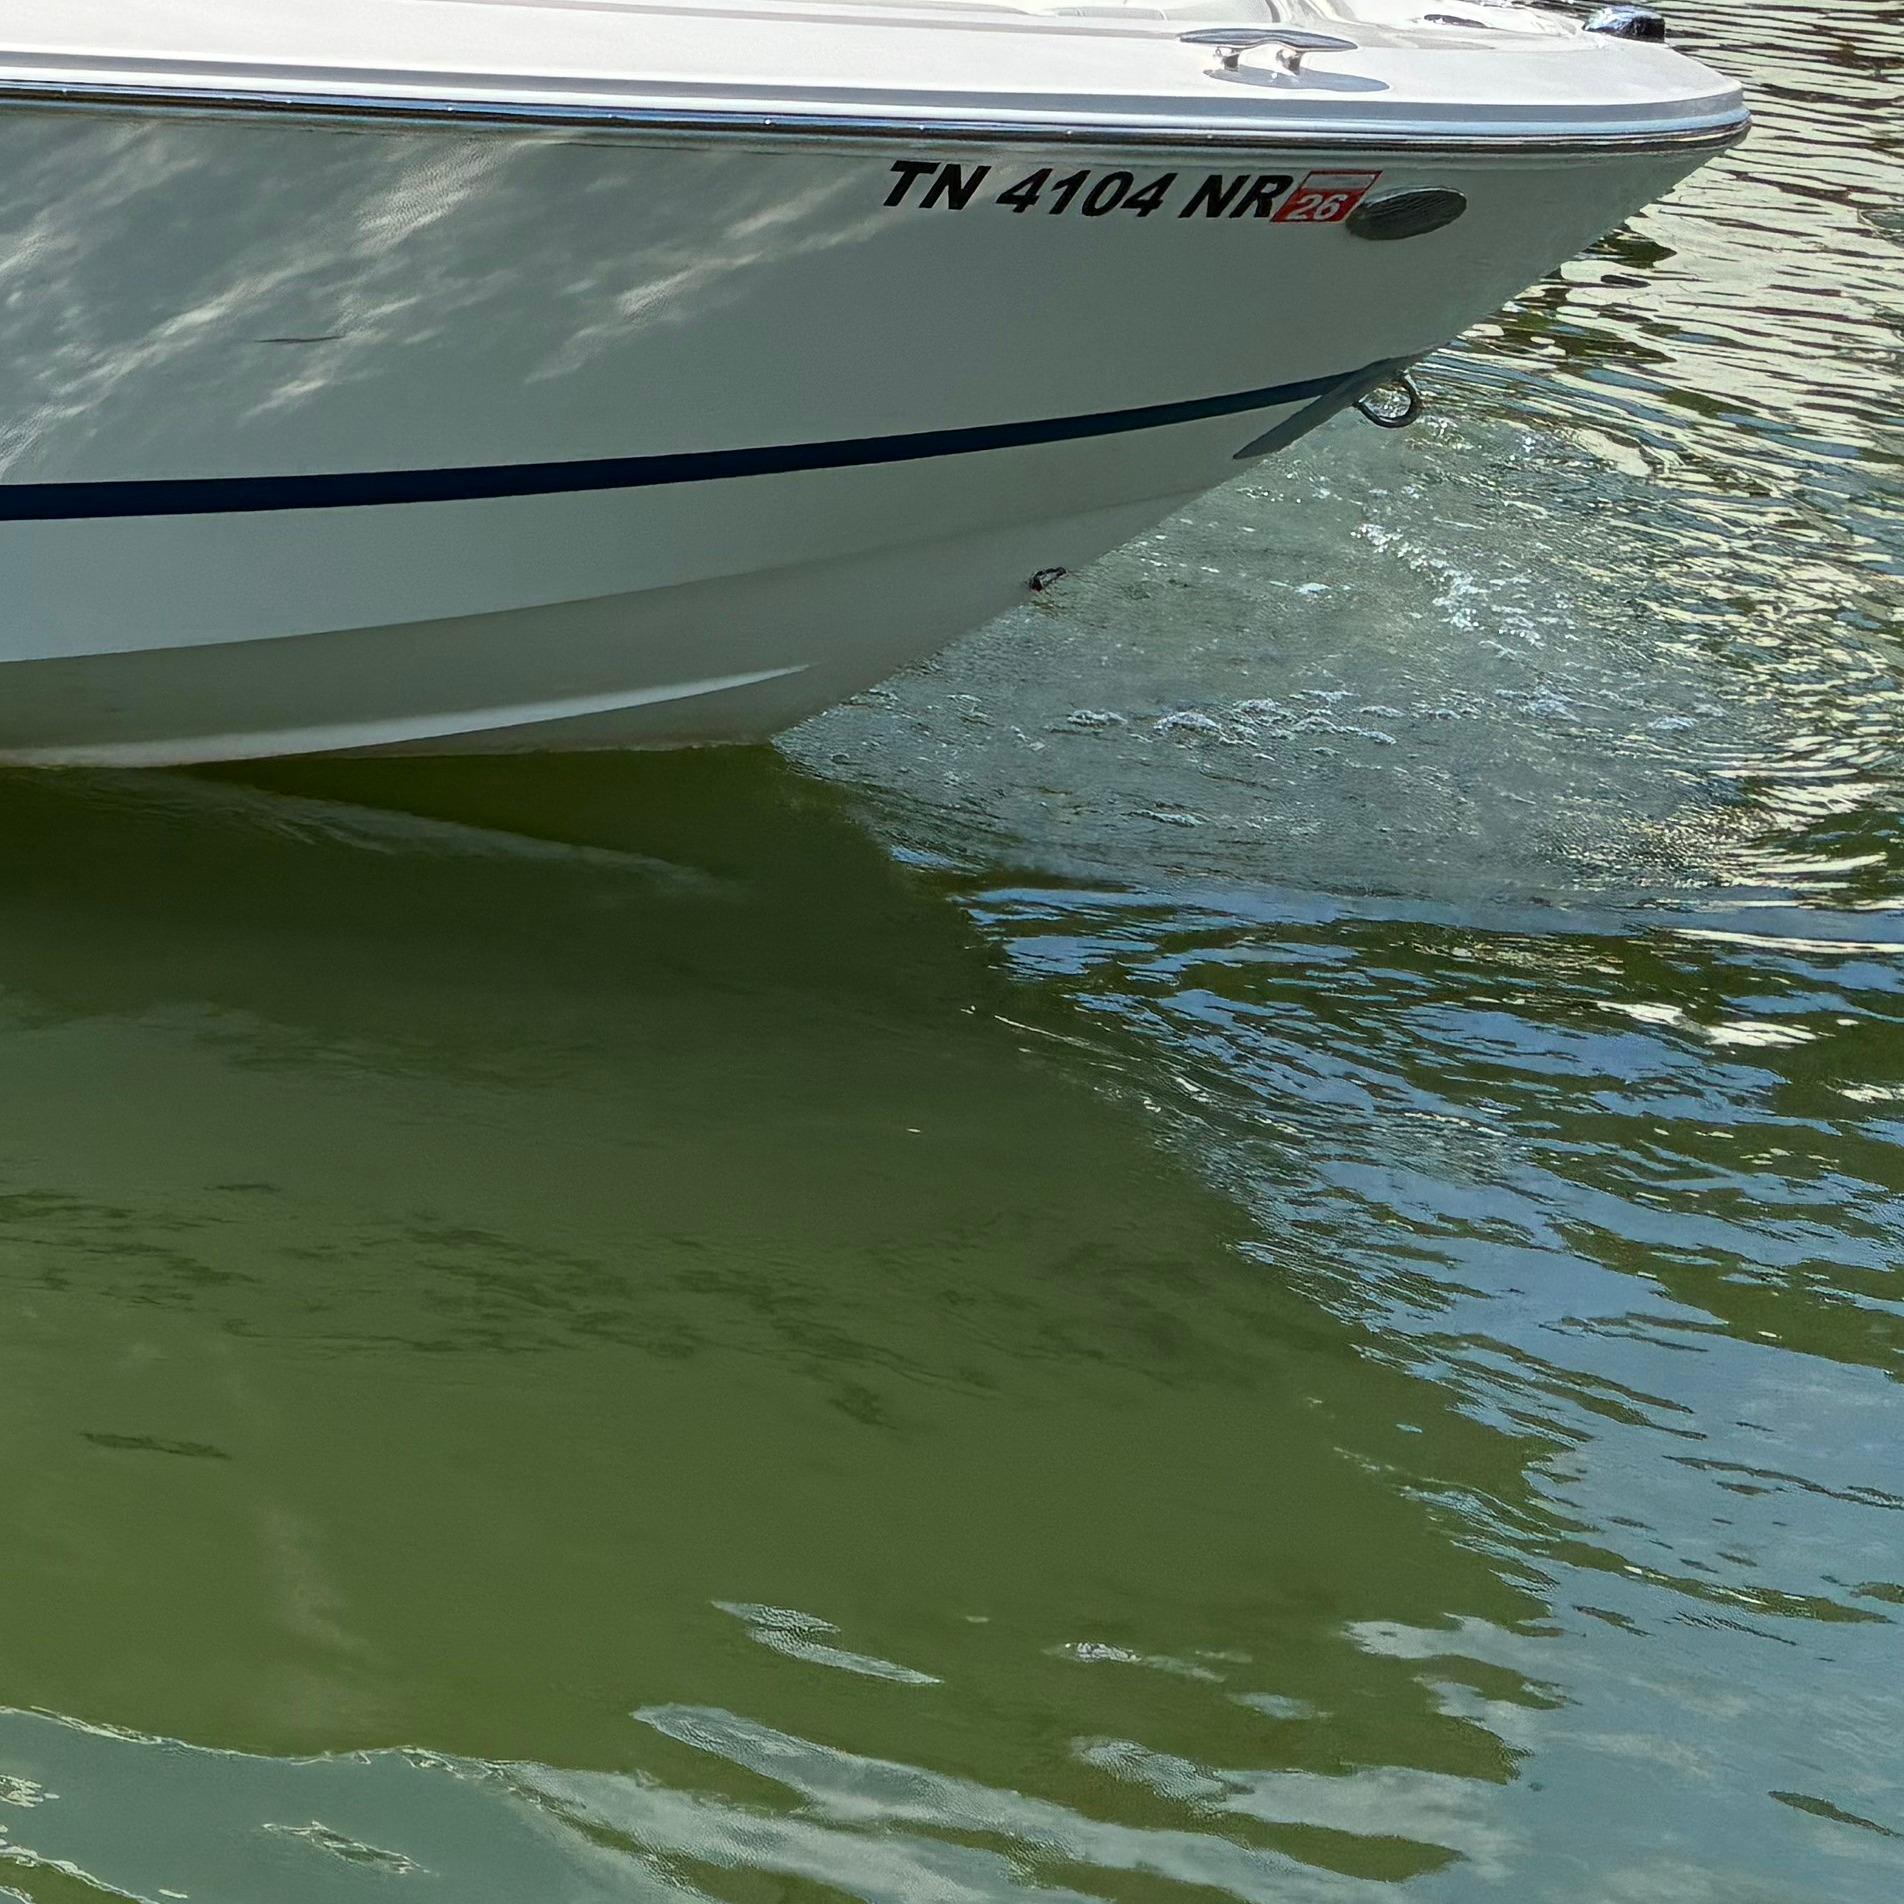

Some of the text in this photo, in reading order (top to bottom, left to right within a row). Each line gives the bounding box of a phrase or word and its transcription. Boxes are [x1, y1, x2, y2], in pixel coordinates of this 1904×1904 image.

[884, 159, 1296, 220] TN 4104 NR
[1288, 193, 1343, 222] 26
